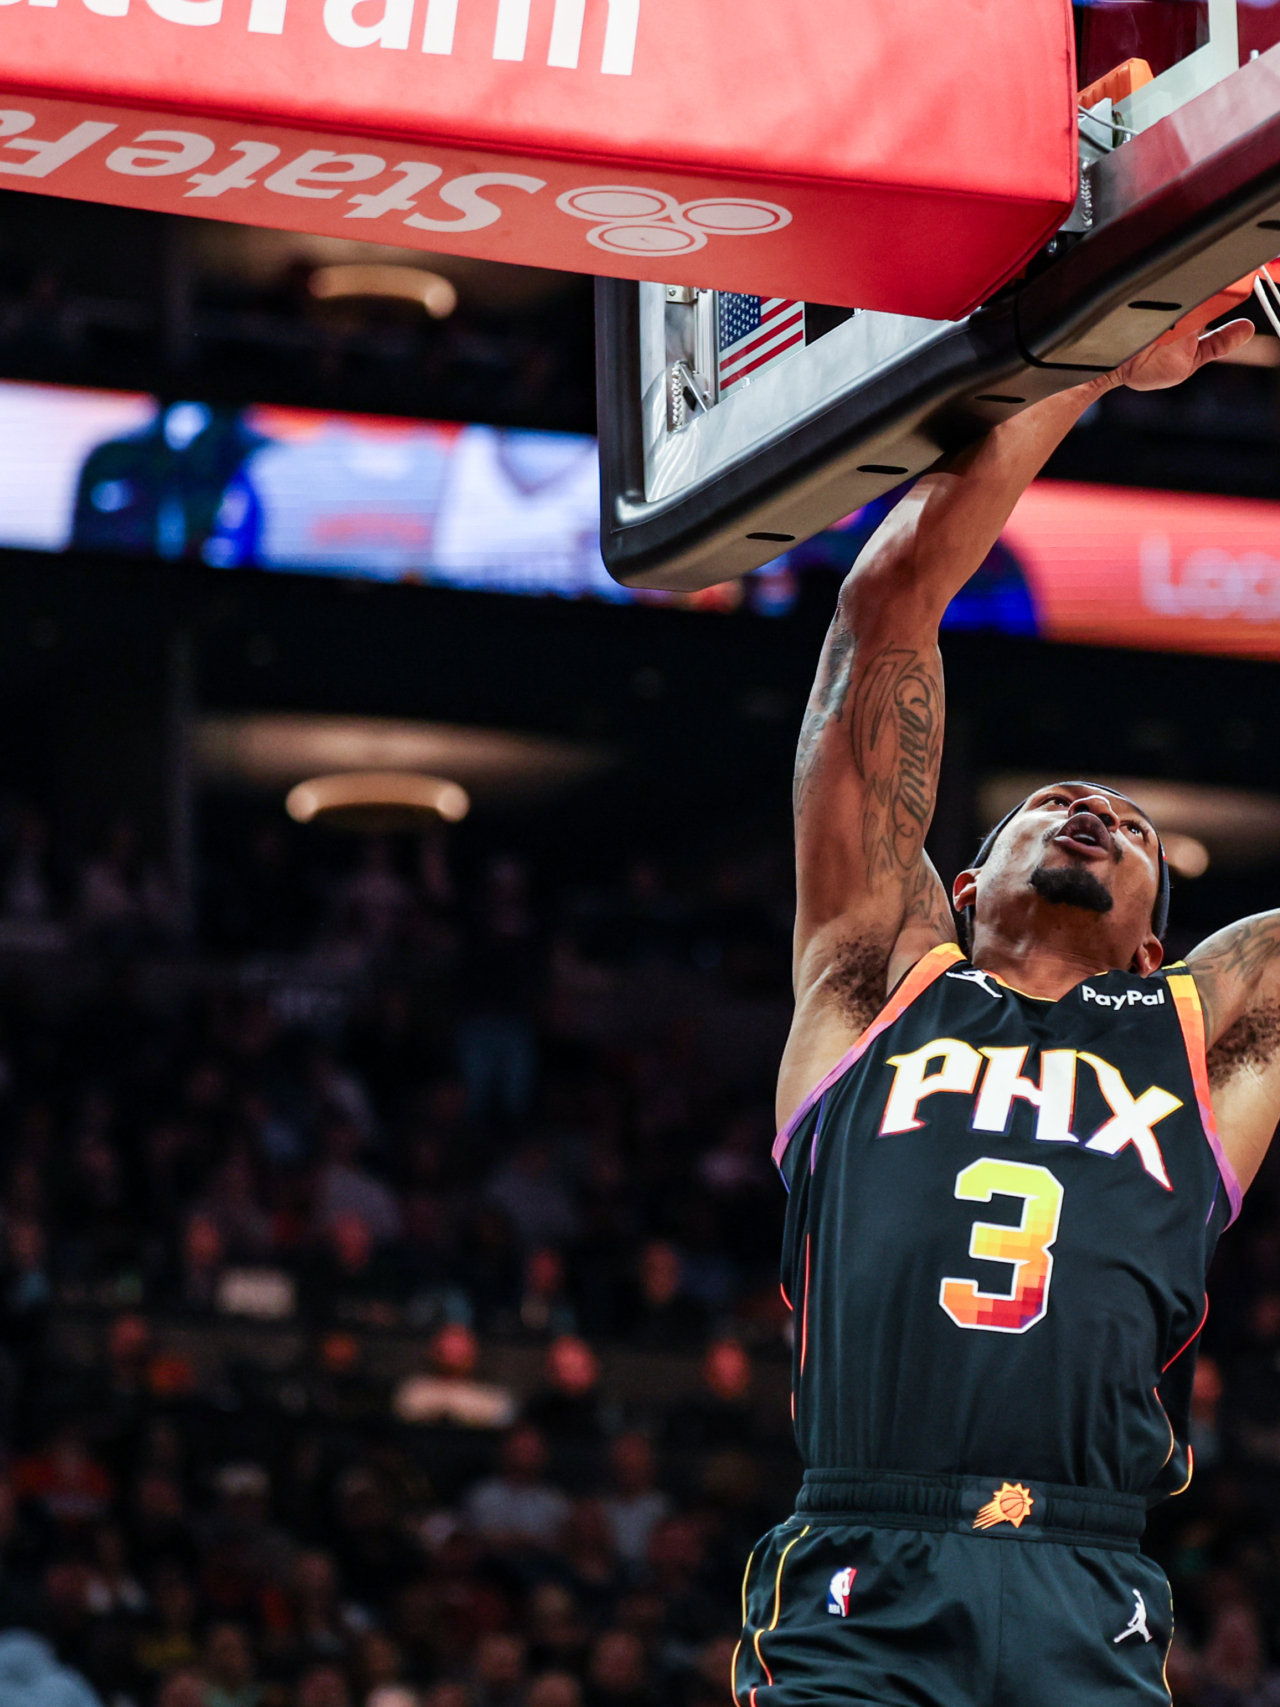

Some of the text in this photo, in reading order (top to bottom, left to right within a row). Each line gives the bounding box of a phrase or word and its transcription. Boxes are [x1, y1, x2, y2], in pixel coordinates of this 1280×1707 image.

[1082, 985, 1165, 1011] PayPal
[878, 1038, 1184, 1191] PHX
[939, 1157, 1064, 1333] 3
